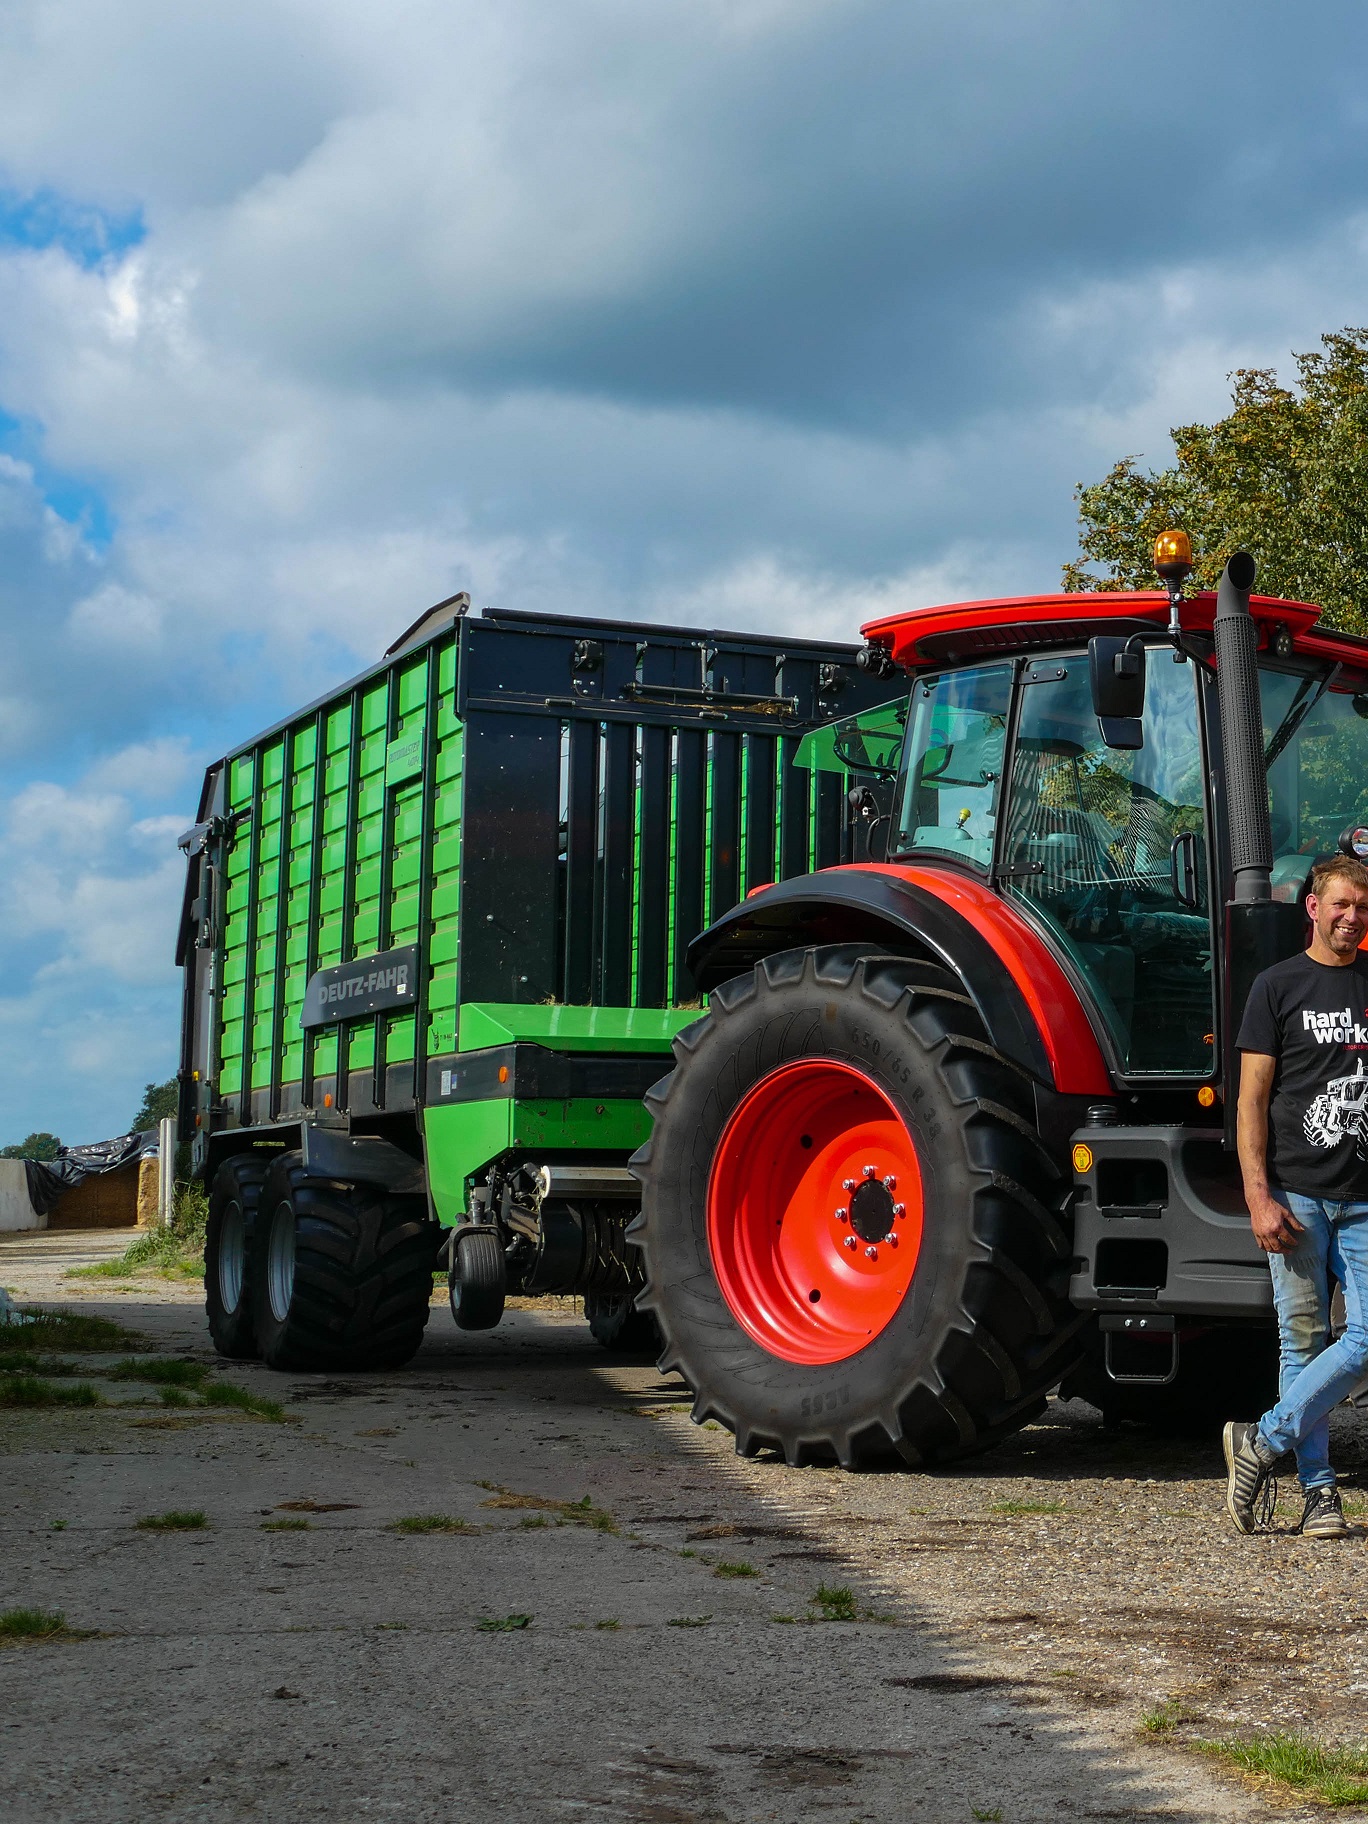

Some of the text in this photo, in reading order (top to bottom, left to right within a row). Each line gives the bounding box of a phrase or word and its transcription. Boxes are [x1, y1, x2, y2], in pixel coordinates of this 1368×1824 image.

[319, 964, 408, 1004] DEUTZ-FAHR
[1302, 1007, 1352, 1031] hard
[912, 1085, 925, 1104] R
